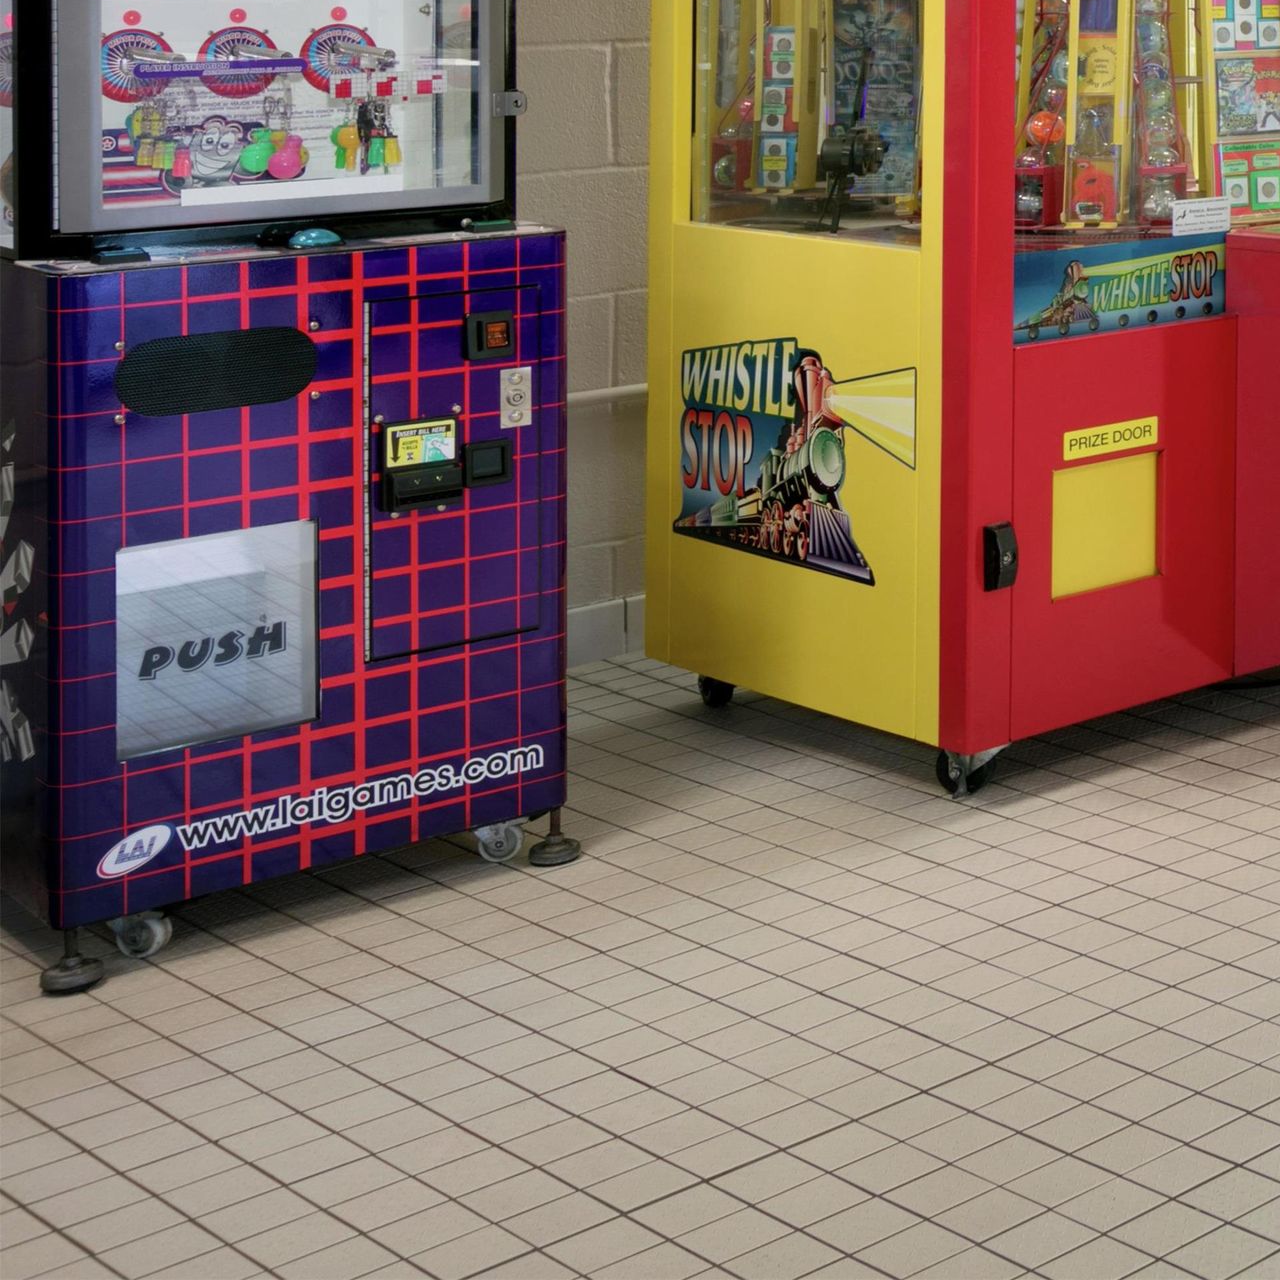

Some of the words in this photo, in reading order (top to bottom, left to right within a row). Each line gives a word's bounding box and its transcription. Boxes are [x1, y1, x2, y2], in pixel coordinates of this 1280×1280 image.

[140, 64, 171, 73] PLAYER
[684, 340, 796, 418] WHISTLE
[396, 429, 418, 439] INSERT
[418, 428, 431, 436] BILL
[431, 426, 447, 434] HERE
[682, 410, 753, 497] STOP
[1069, 432, 1109, 452] PRIZE
[1113, 424, 1152, 444] DOOR
[137, 622, 287, 681] PUSH
[177, 745, 544, 851] www.laigames.com
[114, 834, 158, 865] LAI
